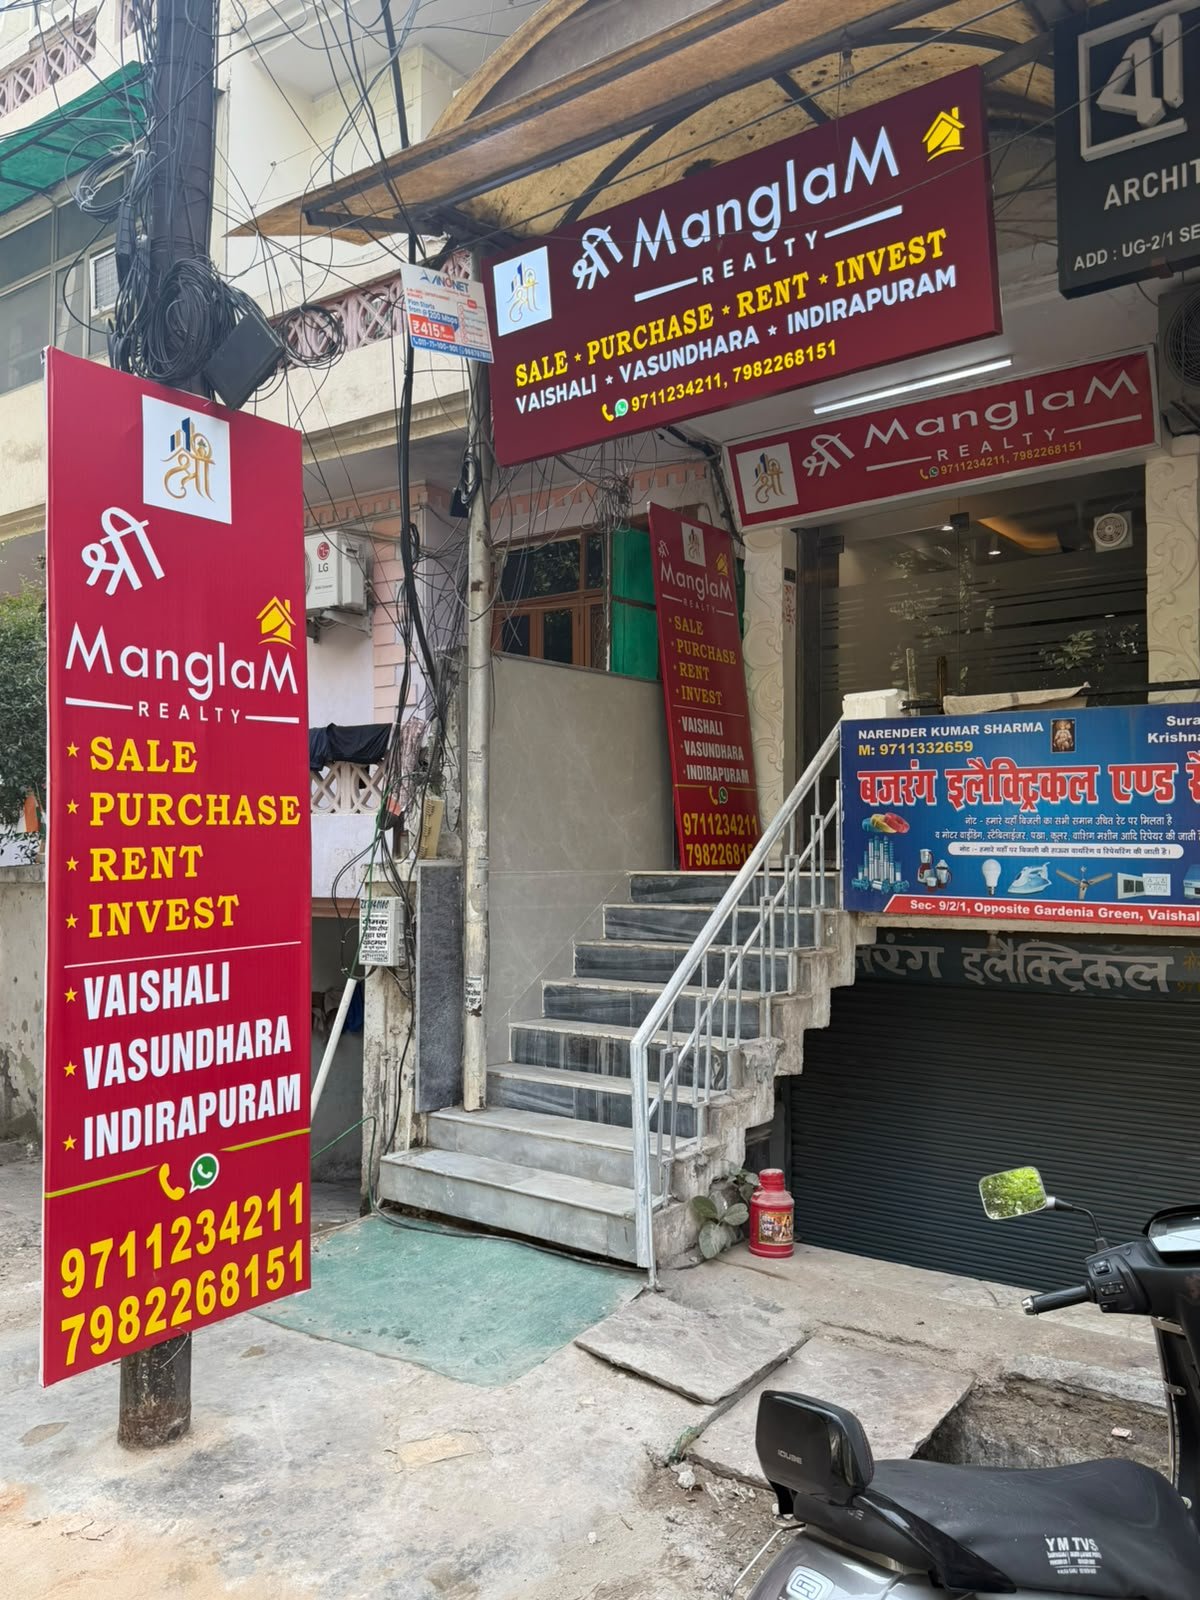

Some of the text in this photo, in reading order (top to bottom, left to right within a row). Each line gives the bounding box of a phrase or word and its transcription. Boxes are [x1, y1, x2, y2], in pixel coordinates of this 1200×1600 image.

[1104, 159, 1200, 211] ARCHIT
[573, 126, 900, 290] श्री ManglaM
[703, 231, 818, 285] REALTY
[1073, 249, 1108, 272] ADD
[1122, 231, 1173, 258] UG-2/1
[1180, 223, 1200, 242] SE
[515, 228, 947, 387] SALE PURCHASE RENT INVEST
[516, 265, 956, 414] VAISHALI VASUNDHARA INDIRAPURAM
[631, 340, 836, 412] 9711234211, 7982268151
[802, 370, 1138, 477] श्री ManglaM
[937, 428, 1055, 461] REALTY
[941, 441, 1082, 476] 9711234211, 7982268151
[81, 507, 165, 595] श्री
[318, 562, 329, 573] LG
[661, 560, 733, 602] ManglaM
[683, 598, 715, 614] REALTY
[674, 615, 704, 636] SALE
[65, 621, 298, 700] ManglaM
[677, 638, 737, 665] PURCHASE
[680, 662, 710, 680] RENT
[138, 702, 241, 724] REALTY
[681, 685, 723, 705] INVEST
[681, 716, 724, 736] VAISHALI
[858, 722, 1043, 739] NARENDER KUMAR SHARMA
[90, 736, 198, 774] SALE
[683, 740, 744, 761] VASUNDHARA
[858, 741, 973, 756] M: 9711332659
[686, 764, 750, 784] INDIRAPURAM
[857, 759, 938, 806] बजरंग
[1108, 763, 1179, 804] एण्ड
[90, 792, 301, 826] PURCHASE
[683, 812, 758, 836] 9711234211
[1095, 814, 1113, 825] उचित
[1116, 814, 1126, 825] रेट
[1128, 817, 1138, 825] पर
[1140, 814, 1164, 825] मिलता
[1097, 829, 1118, 840] मशीन
[1120, 829, 1137, 840] आदि
[1165, 829, 1176, 840] की
[1177, 829, 1196, 840] जाती
[89, 845, 203, 882] RENT
[88, 894, 239, 938] INVEST
[938, 900, 971, 914] 9/2/1,
[974, 902, 1030, 916] Opposite
[1034, 905, 1094, 918] Gardenia
[1098, 907, 1144, 921] Green,
[83, 961, 230, 1020] VAISHALI
[83, 1015, 292, 1090] VASUNDHARA
[83, 1073, 301, 1160] INDIRAPURAM
[61, 1182, 303, 1299] 9711234211
[60, 1240, 303, 1366] 7982268151
[1071, 1537, 1099, 1551] TVS
